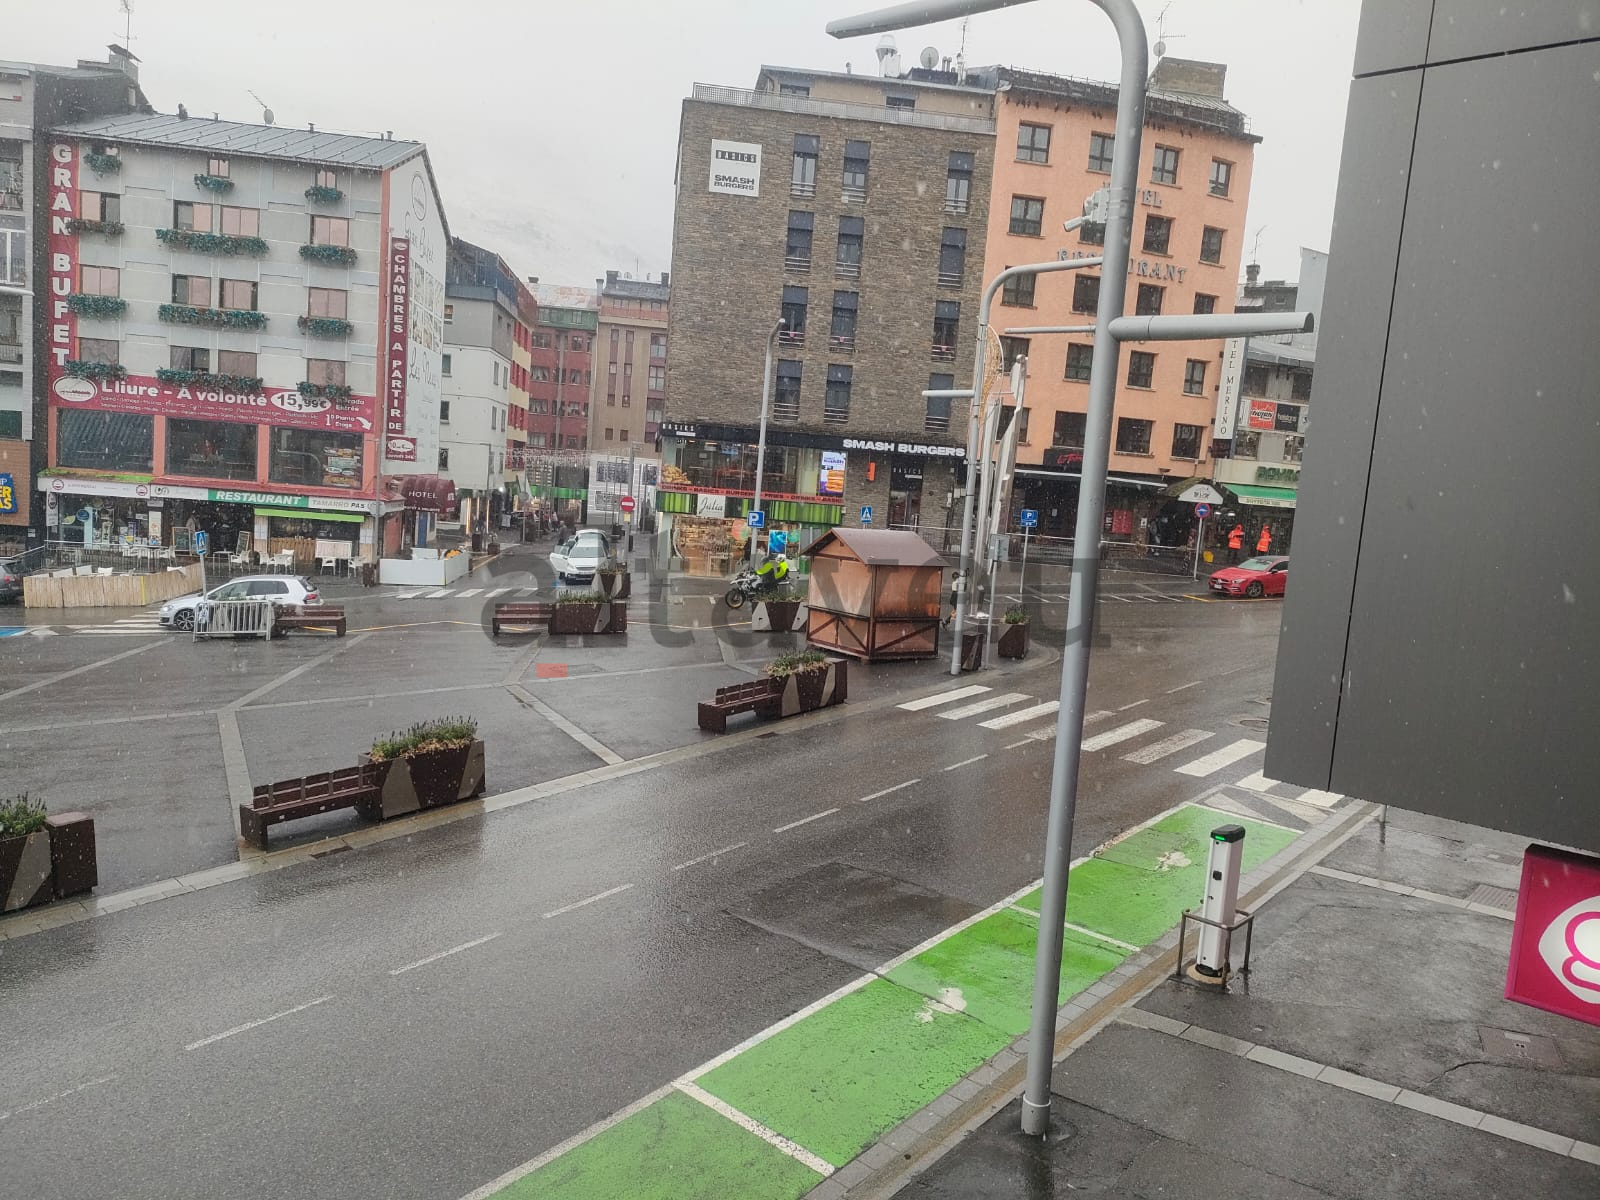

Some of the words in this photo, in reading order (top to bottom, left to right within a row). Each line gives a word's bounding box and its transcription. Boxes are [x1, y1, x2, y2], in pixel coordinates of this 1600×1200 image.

[713, 181, 755, 191] BURGERS
[714, 174, 755, 185] SMASH
[52, 143, 72, 236] GRAN
[392, 254, 406, 333] CHAMBRES
[52, 252, 71, 366] BUFET
[101, 380, 159, 396] Lliure
[196, 387, 267, 407] volonté
[276, 393, 328, 411] 15,99€
[390, 359, 402, 417] PARTIR
[1220, 375, 1234, 436] MERINO
[388, 422, 402, 430] DE
[842, 438, 895, 451] SMASH
[897, 443, 966, 456] BURGERS
[215, 490, 302, 506] RESTAURANT
[408, 490, 438, 499] HOTEL
[749, 513, 760, 526] P
